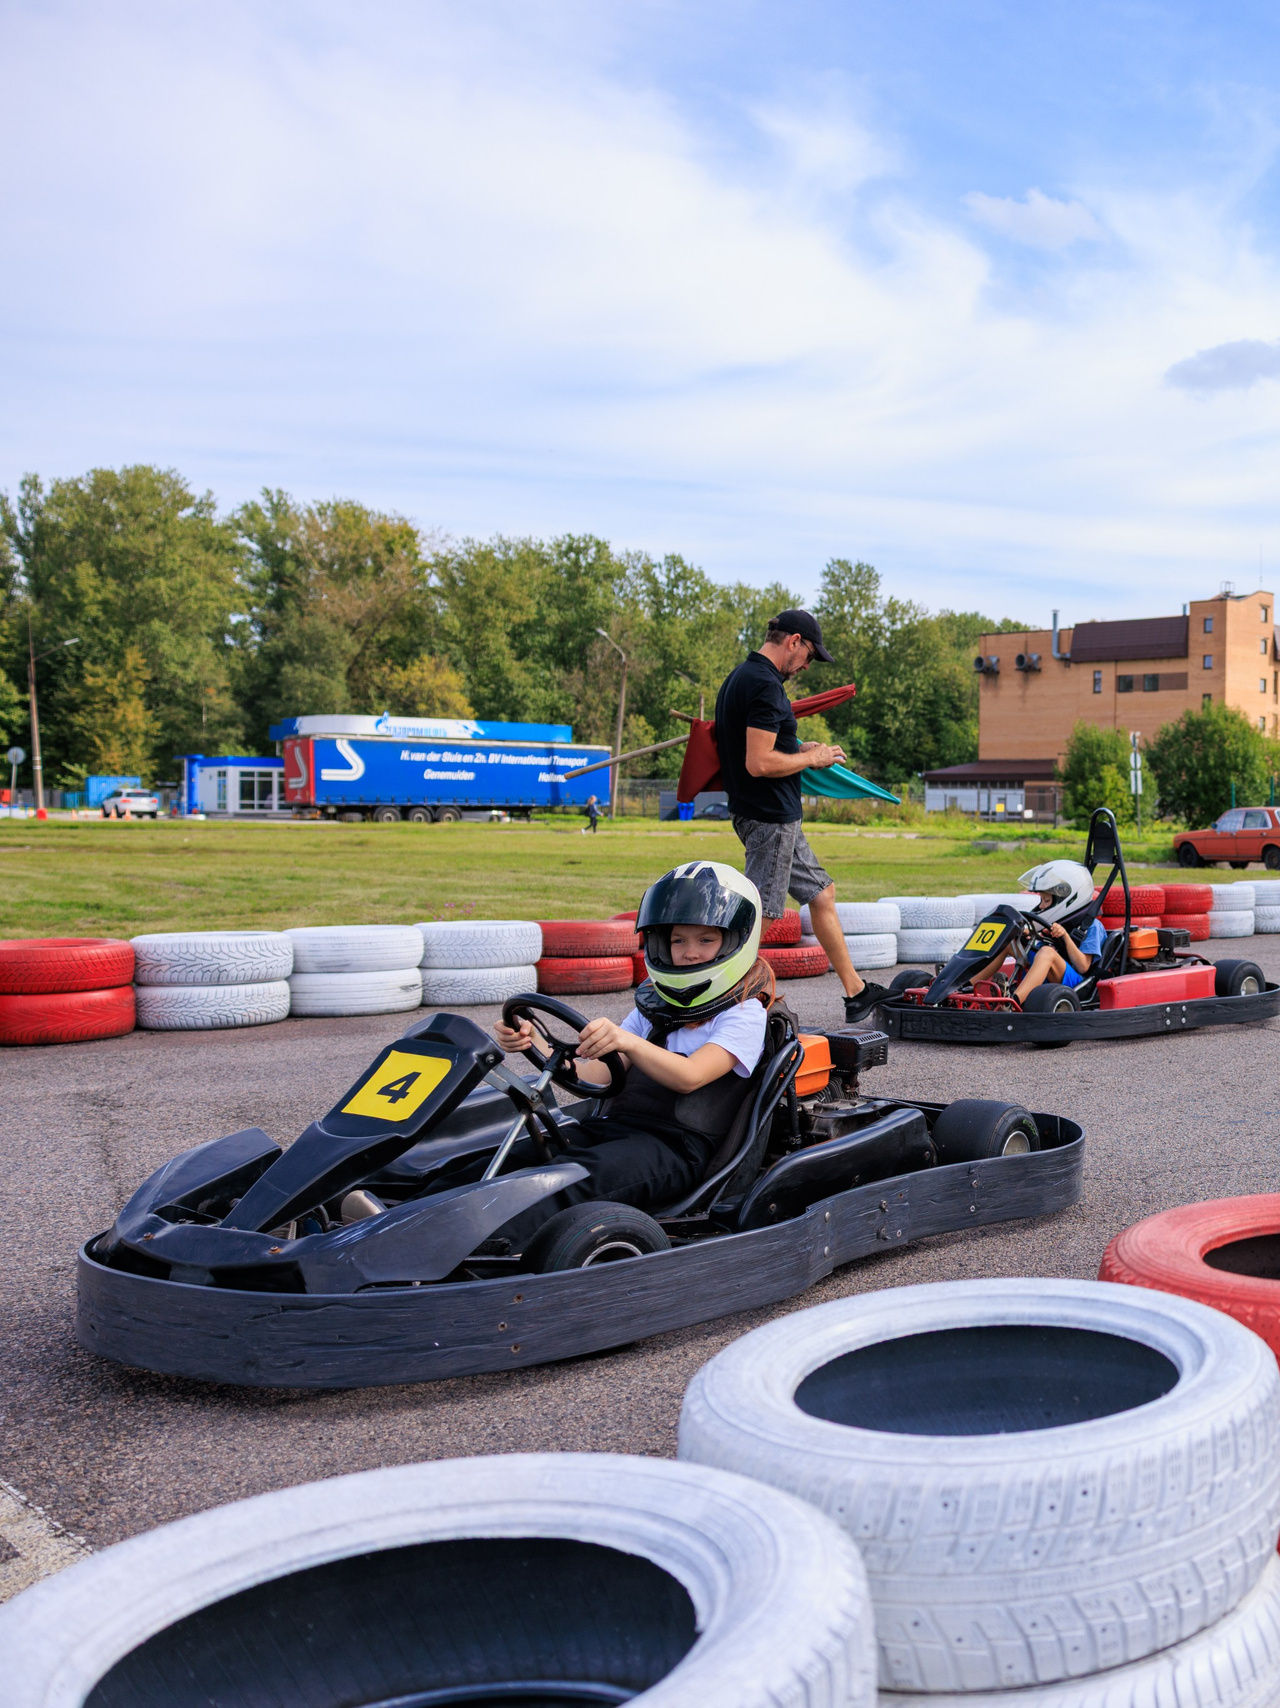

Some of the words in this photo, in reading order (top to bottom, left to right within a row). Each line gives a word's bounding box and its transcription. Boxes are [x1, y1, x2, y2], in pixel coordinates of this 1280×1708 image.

[411, 752, 426, 761] van
[427, 751, 441, 762] der
[442, 752, 463, 763] Sluis
[463, 754, 474, 763] en
[488, 753, 501, 764] BV
[553, 756, 587, 768] Transport
[423, 769, 476, 780] Genemuiden
[975, 929, 996, 944] 10
[376, 1071, 422, 1104] 4
